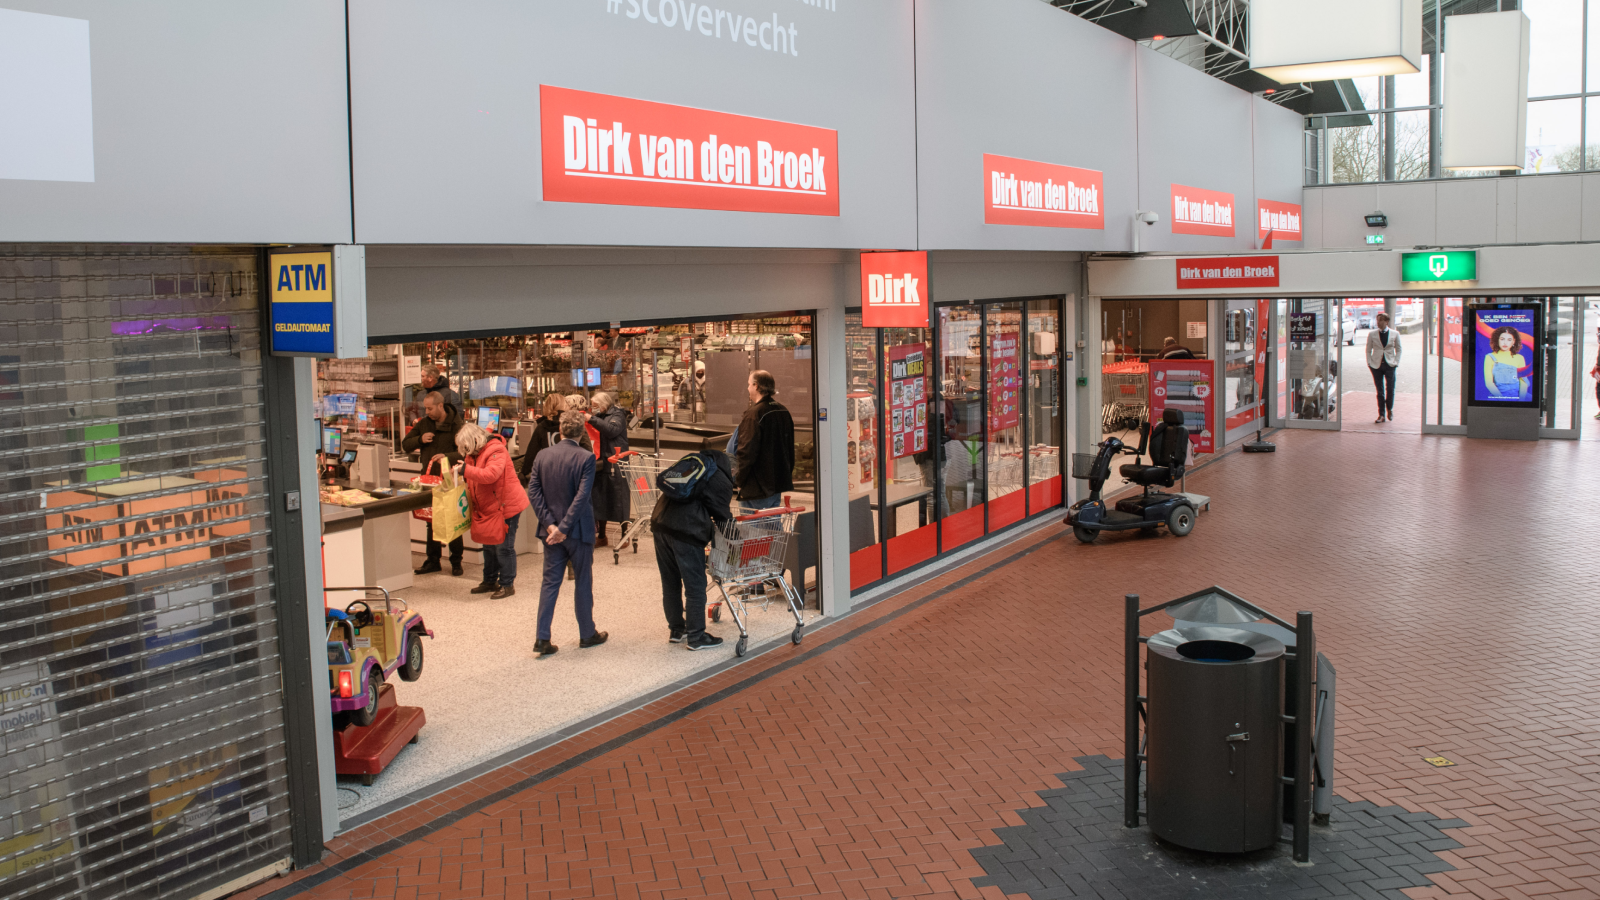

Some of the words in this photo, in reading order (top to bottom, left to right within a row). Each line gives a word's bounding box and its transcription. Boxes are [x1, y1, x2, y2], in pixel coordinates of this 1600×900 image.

[563, 115, 633, 174] Dirk
[639, 133, 694, 180] van
[701, 134, 750, 184] den
[757, 140, 826, 190] Broek
[992, 171, 1018, 206] Dirk
[1020, 180, 1042, 208] van
[1045, 179, 1065, 210] den
[1068, 181, 1098, 213] Broek
[1175, 195, 1189, 220] Dirk
[1190, 202, 1201, 222] van
[1203, 200, 1214, 223] den
[1215, 201, 1232, 225] Broek
[1261, 208, 1270, 228] Dirk
[1279, 211, 1287, 229] den
[1287, 211, 1299, 231] Broek
[277, 264, 326, 291] ATM
[1180, 267, 1200, 278] Dirk
[1202, 268, 1221, 278] van
[1222, 266, 1242, 277] den
[1244, 265, 1275, 277] Broek
[868, 273, 920, 303] Dirk
[275, 323, 331, 332] GELDAUTOMAAT
[893, 361, 907, 378] Dirk
[907, 360, 923, 376] DEALS
[62, 514, 103, 544] ATM
[131, 511, 205, 550] ATM
[22, 852, 54, 868] SONY
